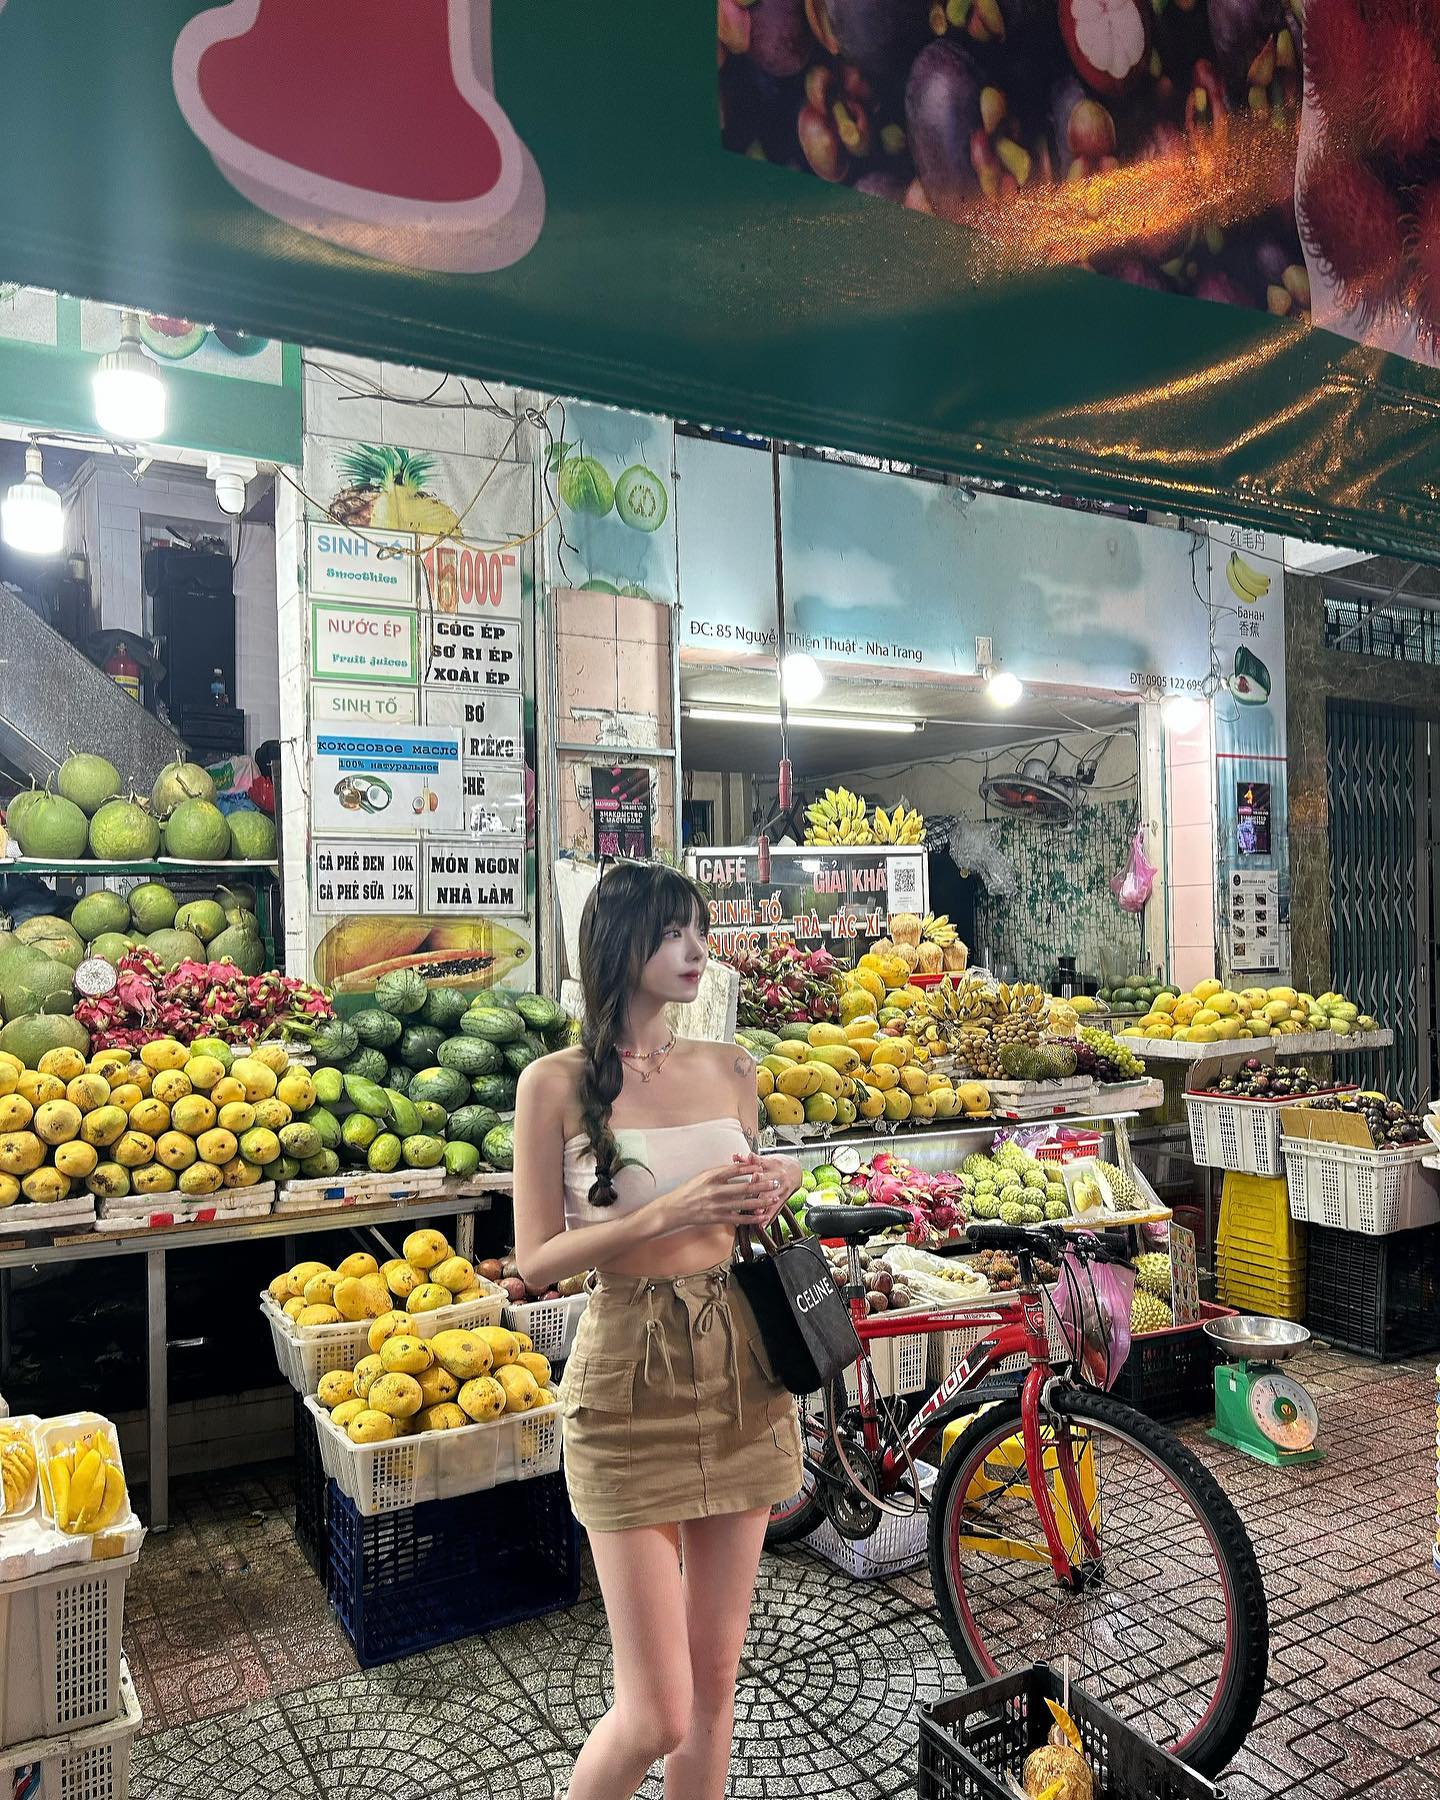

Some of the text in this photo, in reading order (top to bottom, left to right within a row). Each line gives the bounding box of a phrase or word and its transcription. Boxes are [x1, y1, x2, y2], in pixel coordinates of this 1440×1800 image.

[317, 534, 368, 557] SINH
[1230, 530, 1266, 551] 红毛丹
[326, 567, 398, 584] Smoothies
[328, 618, 402, 638] NƯỚC ÉP
[481, 623, 506, 640] ÉP
[1239, 621, 1260, 638] 香蕉
[690, 620, 713, 637] ĐC:
[716, 623, 732, 639] 85
[822, 636, 856, 655] Thuật
[866, 641, 889, 657] Nha
[893, 644, 923, 663] Trang
[462, 647, 482, 661] RI
[488, 646, 513, 663] ÉP
[433, 666, 510, 685] XOÀI ÉP
[1146, 674, 1167, 688] 0905
[1170, 677, 1185, 689] 122
[332, 696, 398, 714] SINH TỐ
[465, 701, 485, 722] BƠ
[318, 740, 458, 756] кокосовое масло
[319, 850, 334, 871] CÀ
[337, 850, 360, 871] PHÊ
[392, 855, 414, 871] 10K
[431, 852, 469, 874] MÓN
[319, 880, 414, 900] CÀ PHÊ SỮA 12K
[437, 882, 514, 904] NHÀ LÀM
[708, 890, 782, 924] SINH TỐ
[793, 908, 822, 939] TRÀ
[829, 906, 857, 938] TẮC
[865, 907, 881, 937] XÍ
[797, 1277, 833, 1312] CELINE
